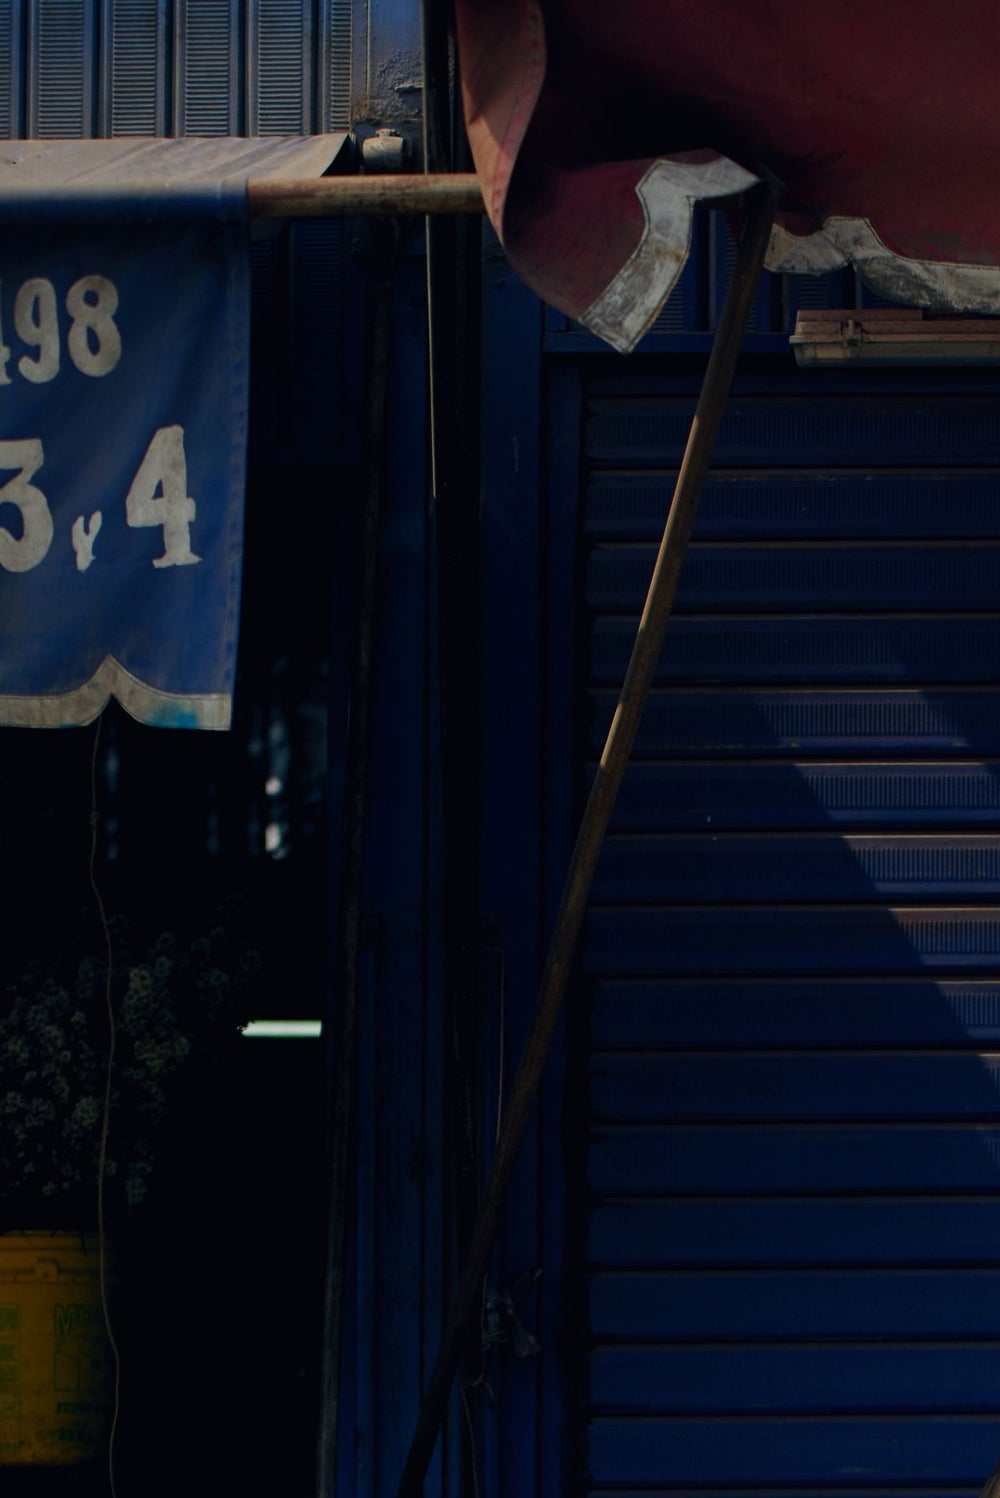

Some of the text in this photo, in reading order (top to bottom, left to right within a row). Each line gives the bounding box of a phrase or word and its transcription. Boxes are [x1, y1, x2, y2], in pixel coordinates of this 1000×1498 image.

[0, 275, 122, 385] 98
[0, 438, 54, 573] 3
[125, 424, 203, 568] 4
